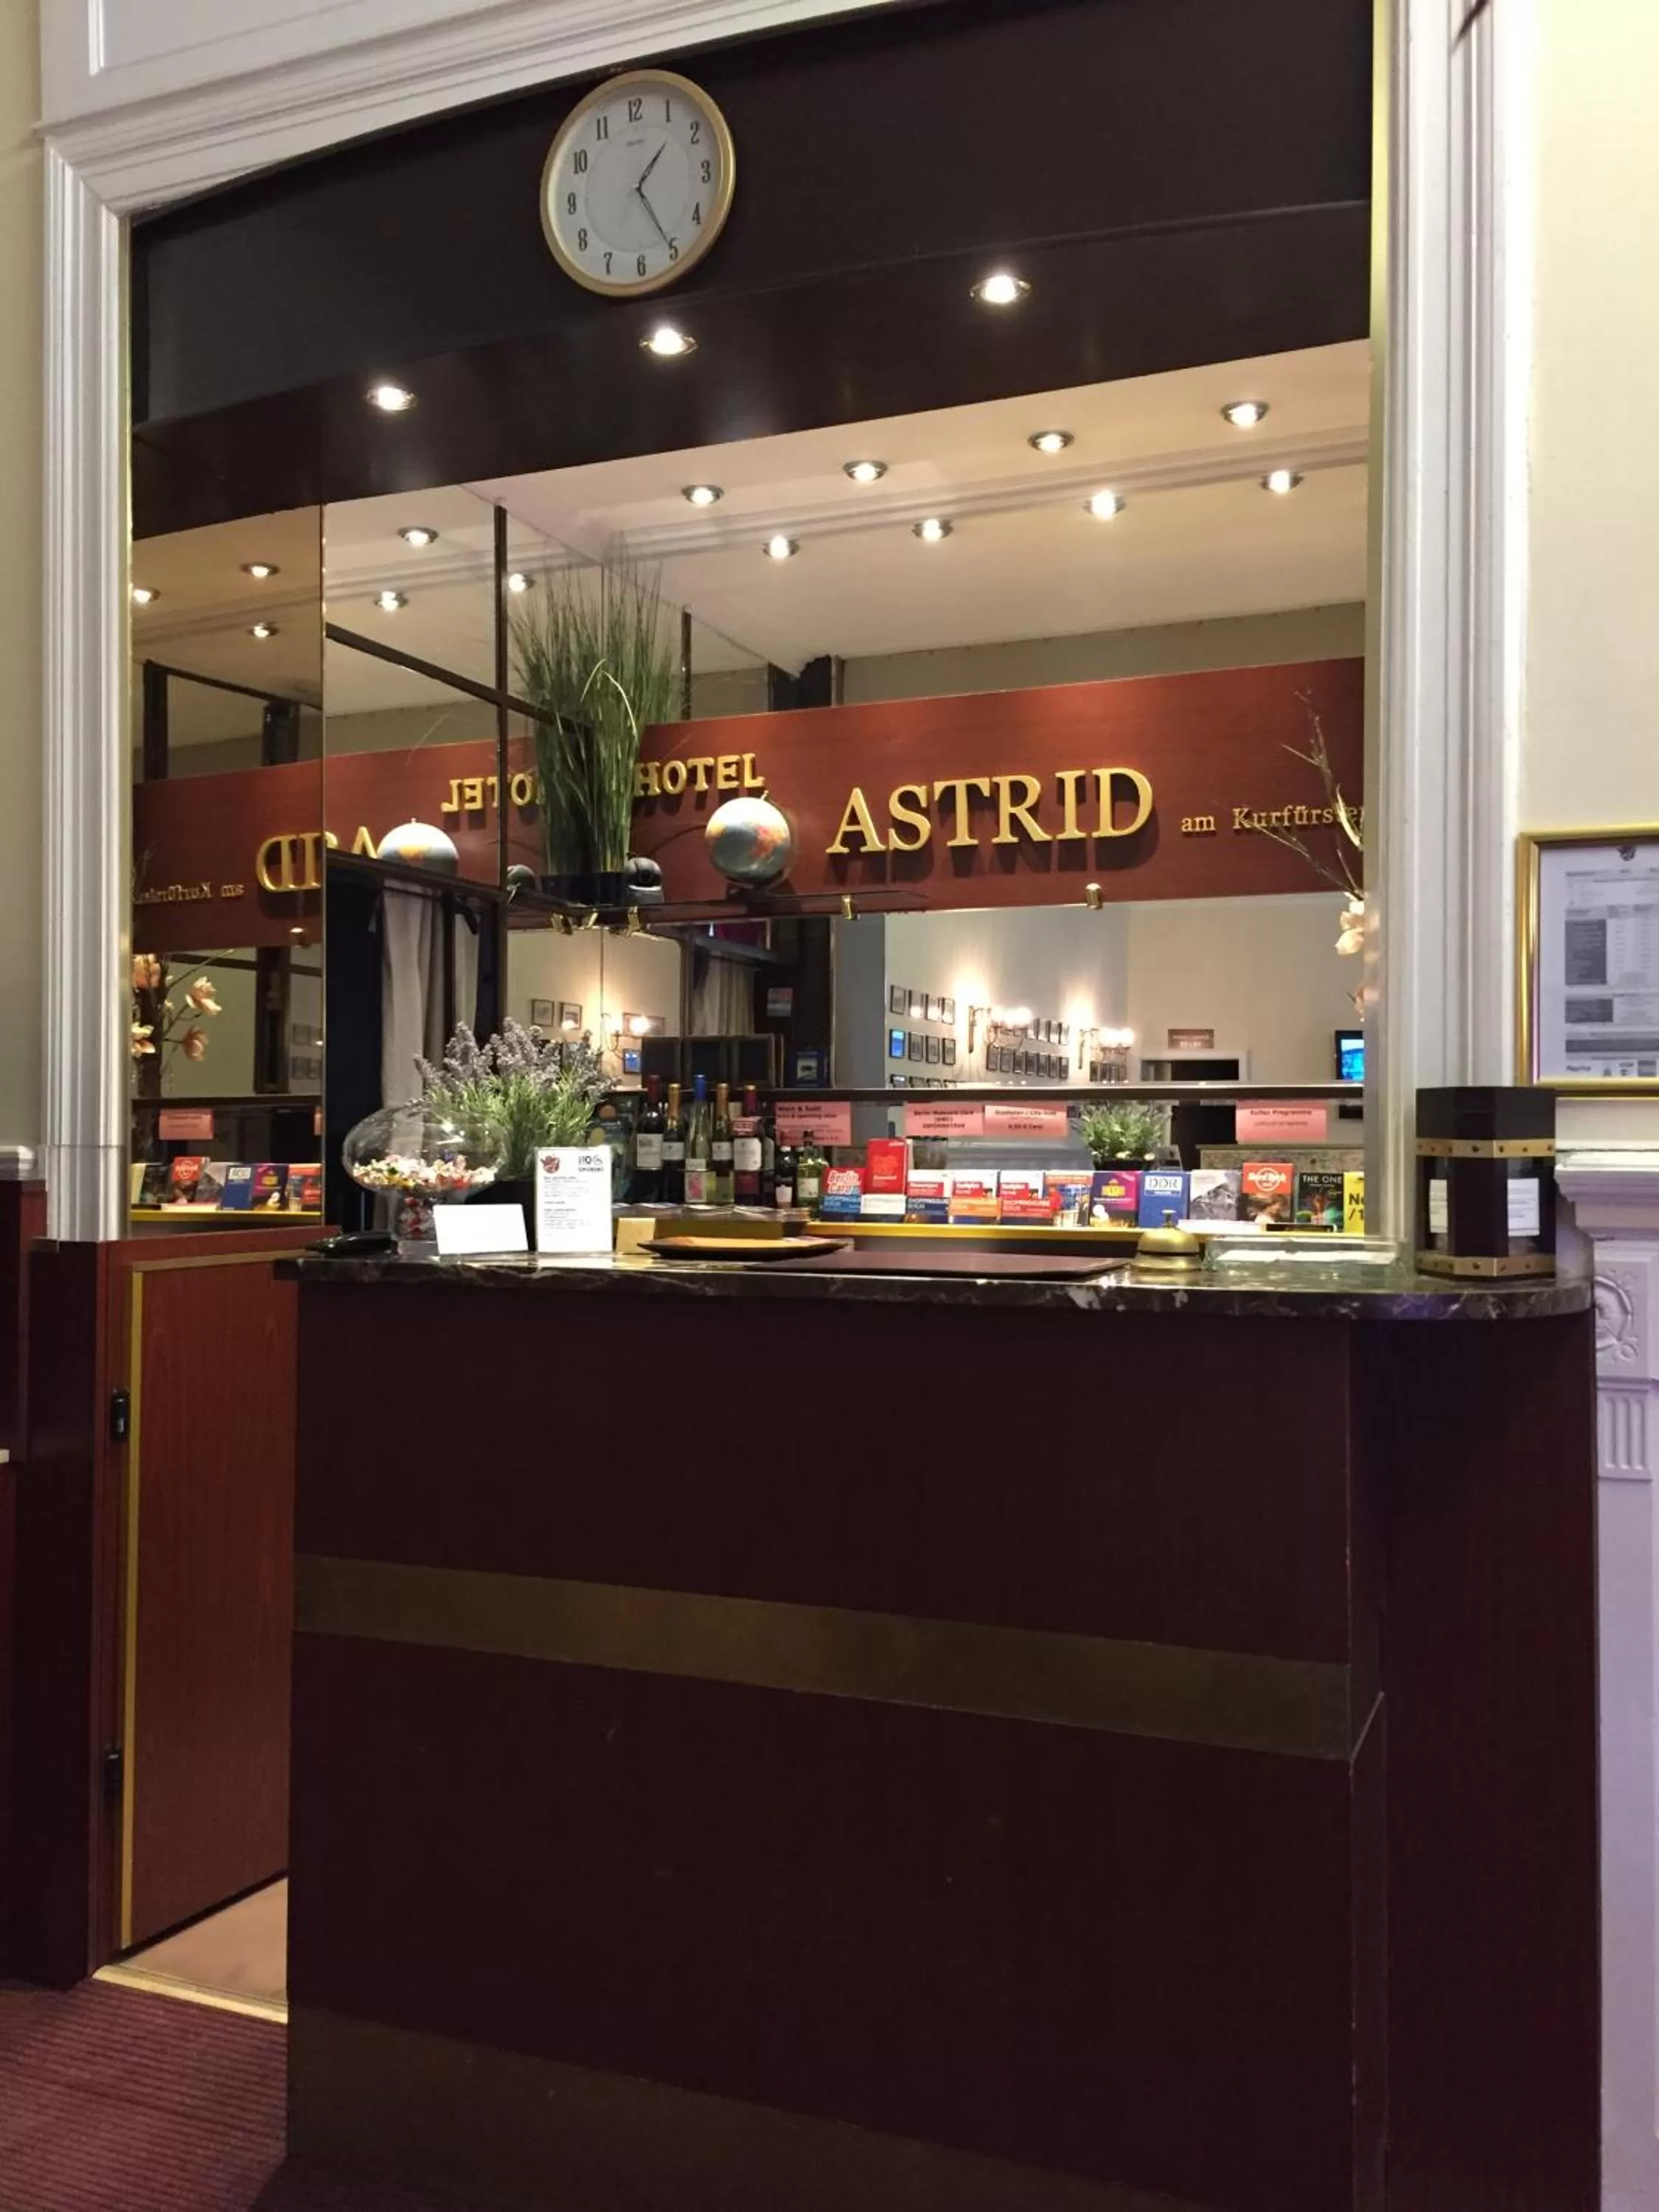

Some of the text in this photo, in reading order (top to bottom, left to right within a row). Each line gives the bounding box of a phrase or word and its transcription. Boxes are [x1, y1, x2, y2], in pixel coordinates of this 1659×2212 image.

[628, 97, 643, 123] 12
[665, 99, 672, 124] 1
[596, 116, 609, 141] 11
[689, 120, 700, 145] 2
[573, 149, 588, 175] 10
[701, 159, 711, 184] 3
[567, 192, 577, 215] 9
[691, 201, 701, 225] 4
[577, 227, 588, 251] 8
[669, 236, 678, 261] 5
[603, 251, 613, 275] 7
[636, 254, 646, 276] 6
[634, 752, 766, 797] HOTEL
[824, 766, 1154, 855] ASTRID
[1181, 815, 1216, 832] am
[1149, 1178, 1178, 1189] DDR
[1302, 1174, 1342, 1184] THE ONE
